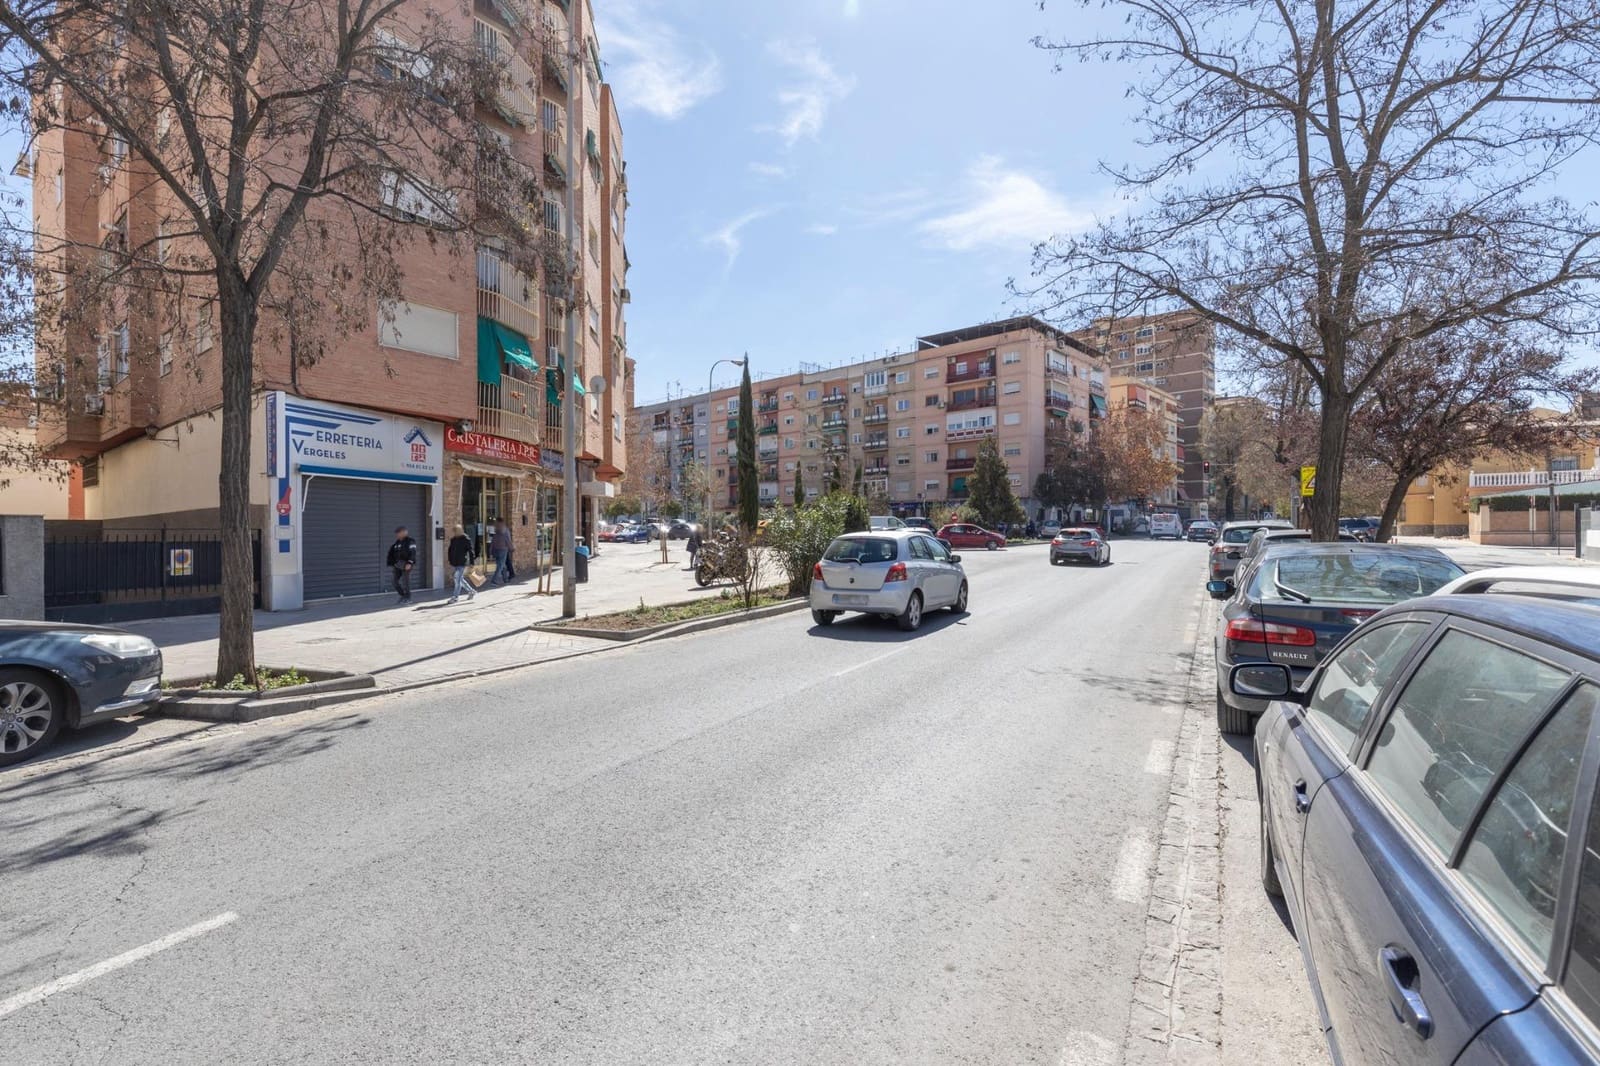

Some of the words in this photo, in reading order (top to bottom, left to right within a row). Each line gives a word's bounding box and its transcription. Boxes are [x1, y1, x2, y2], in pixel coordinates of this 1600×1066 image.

[292, 438, 346, 460] VERGELES
[448, 428, 516, 453] CRISTALERIA
[1272, 651, 1308, 660] RENAULT
